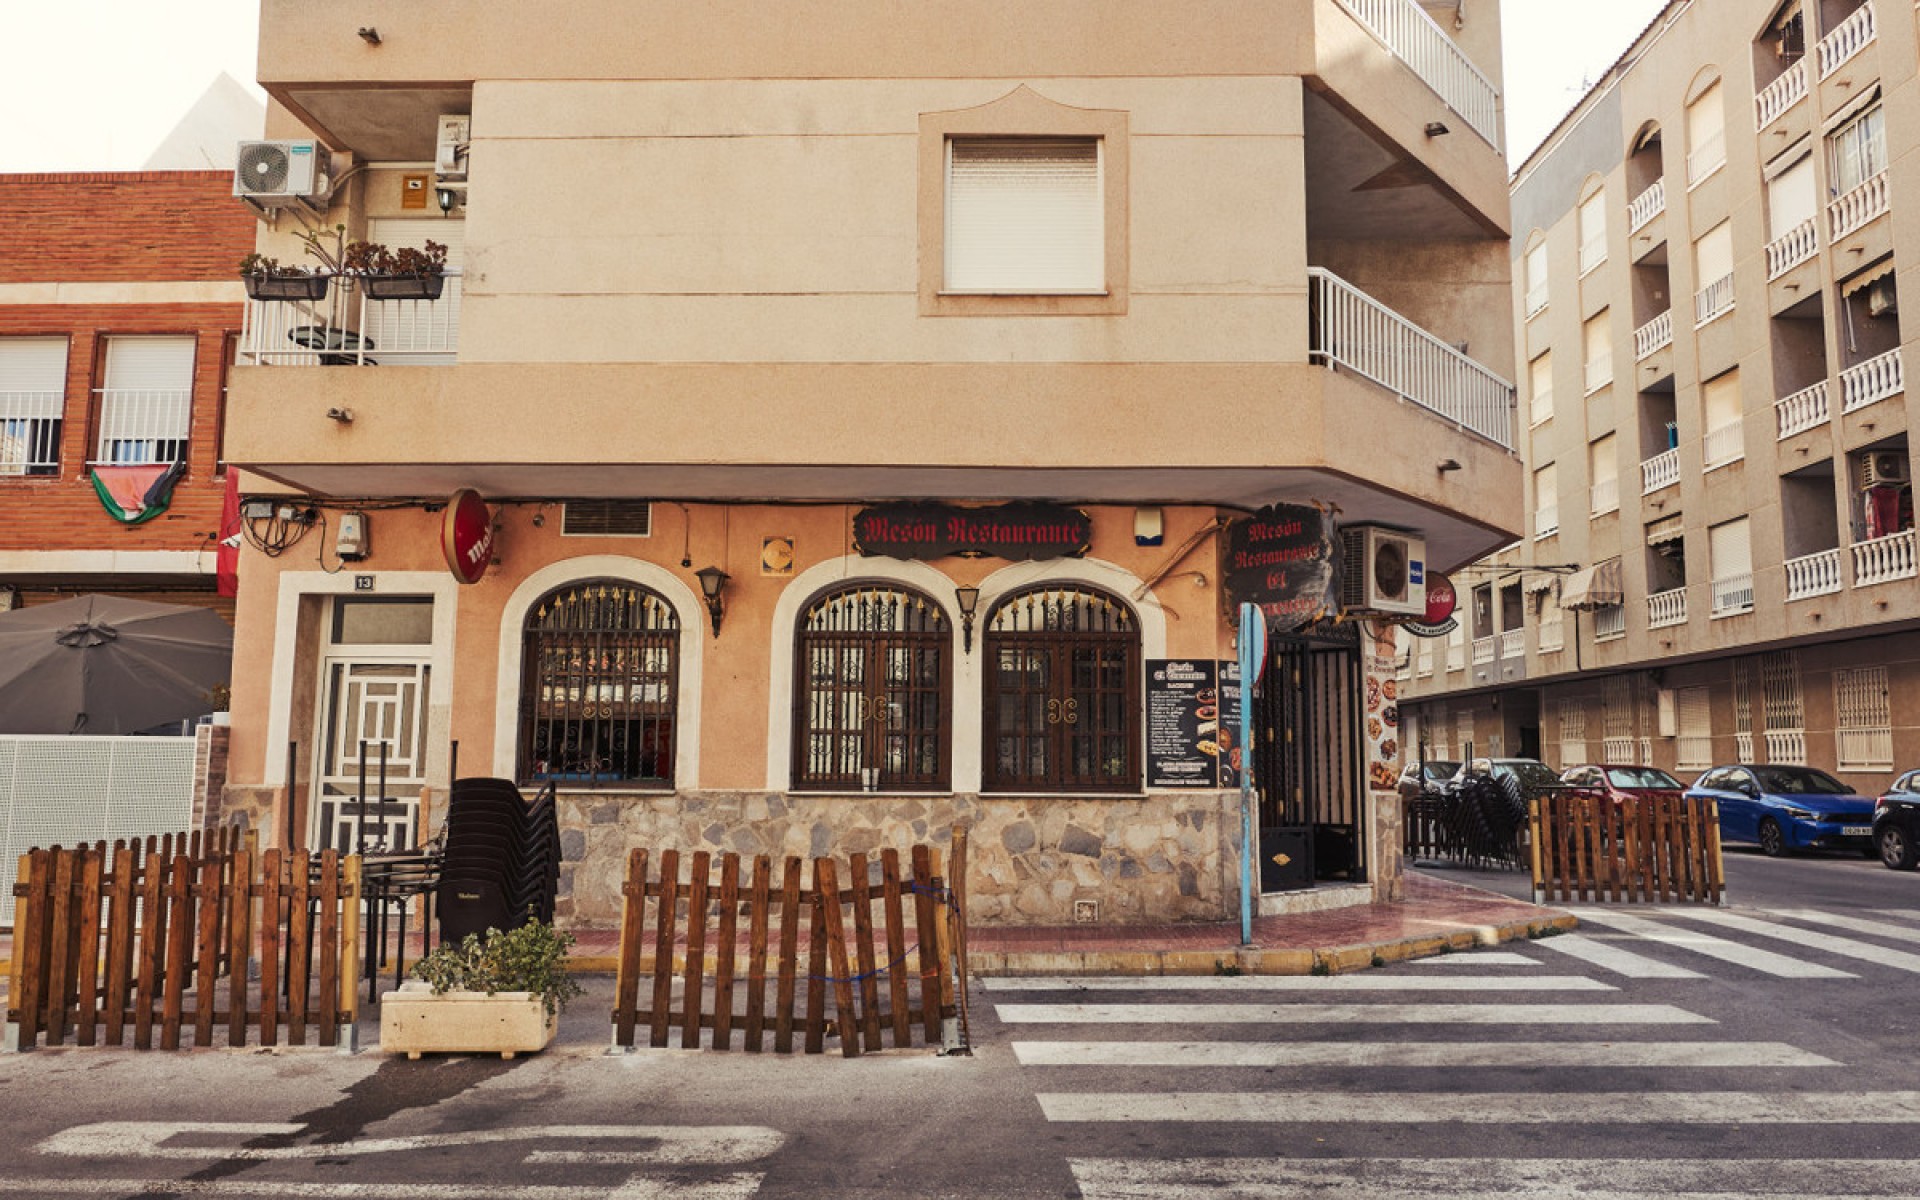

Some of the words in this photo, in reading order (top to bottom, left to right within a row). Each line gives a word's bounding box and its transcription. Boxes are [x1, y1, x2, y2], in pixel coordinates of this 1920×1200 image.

[863, 516, 937, 543] Mesón
[947, 516, 1082, 544] Restaurante
[1248, 519, 1302, 542] Mesón
[357, 577, 371, 588] 13
